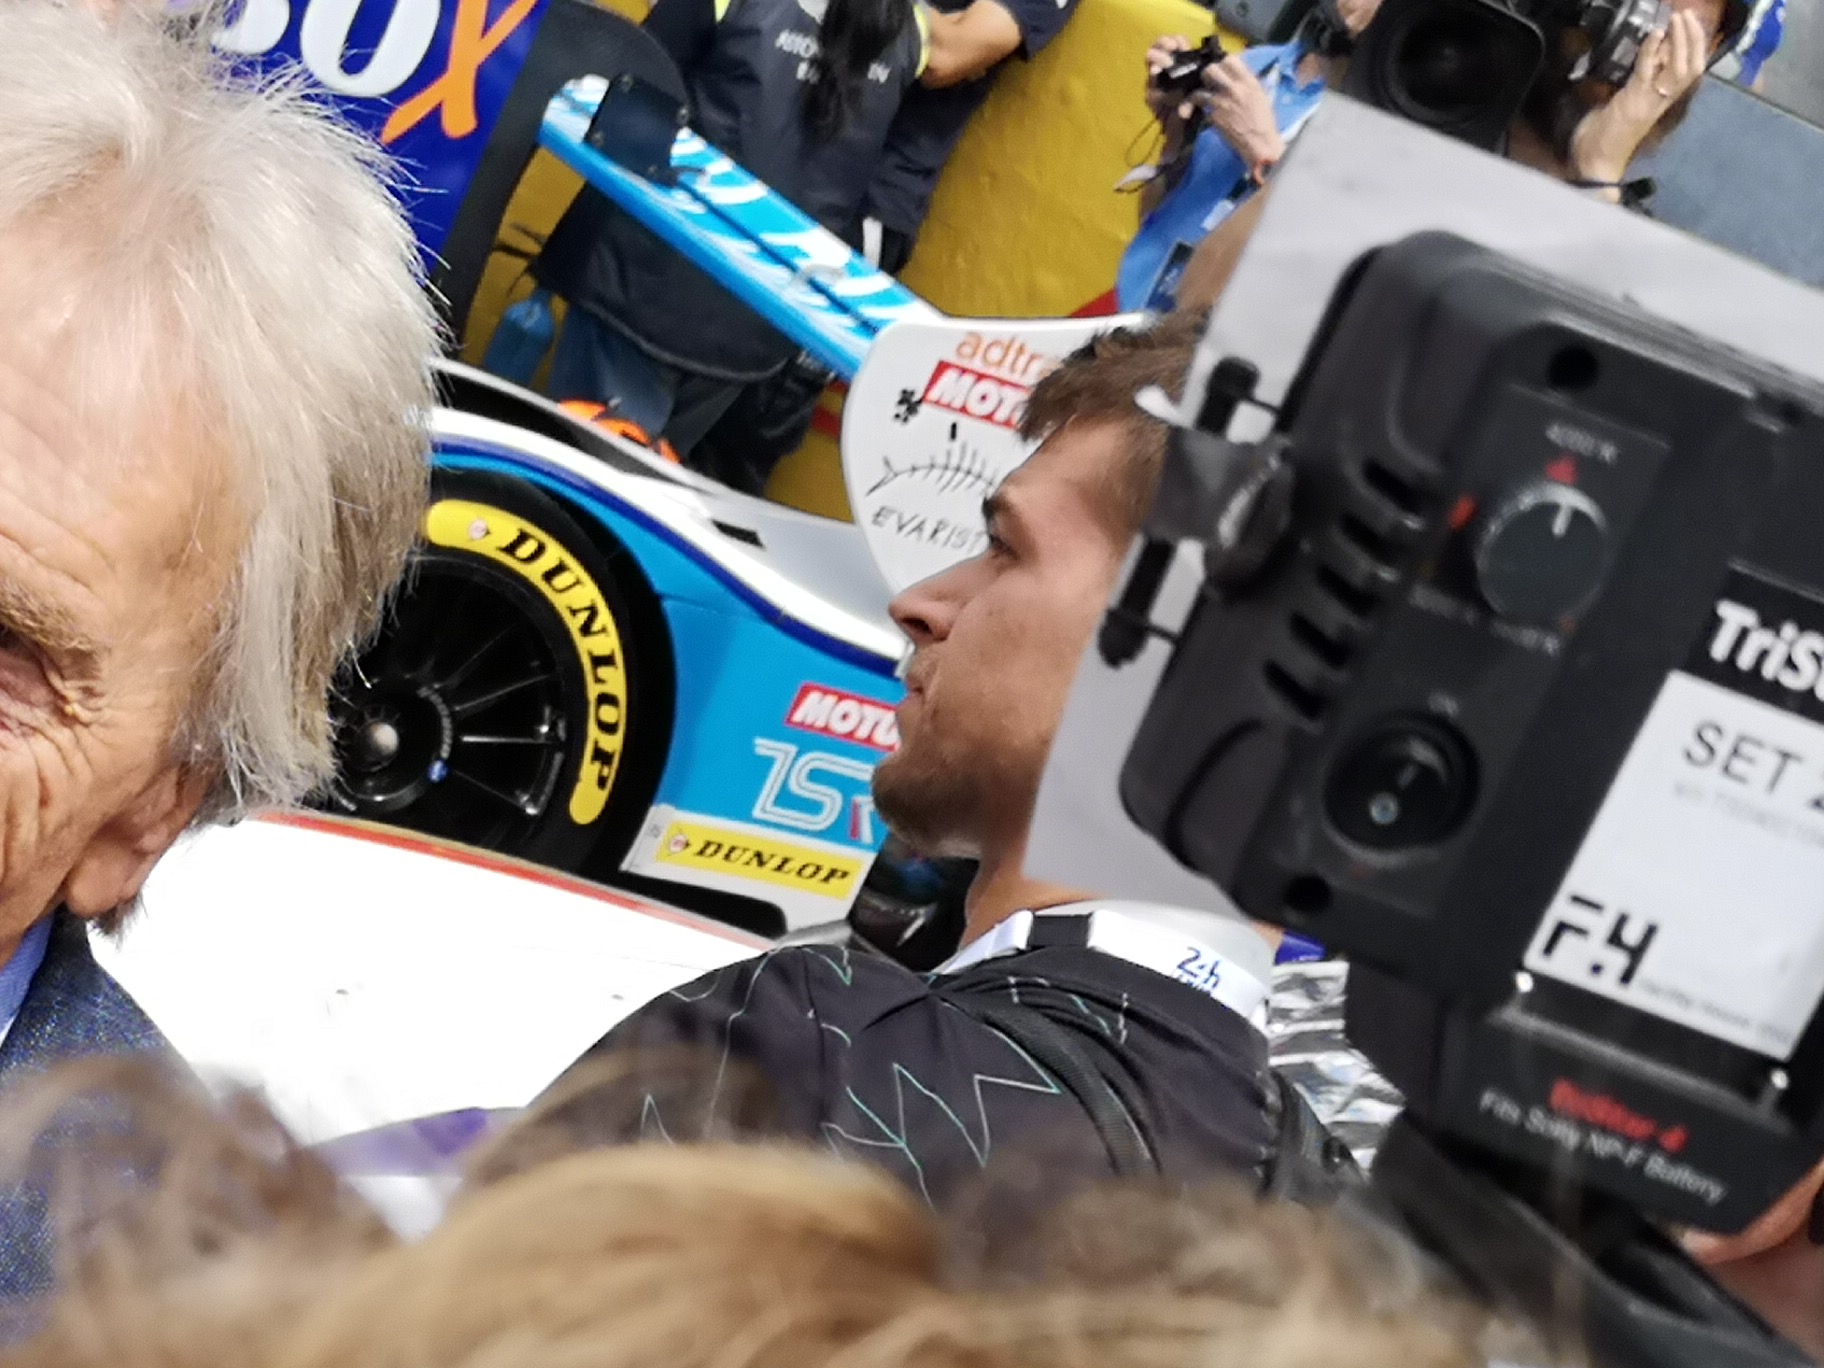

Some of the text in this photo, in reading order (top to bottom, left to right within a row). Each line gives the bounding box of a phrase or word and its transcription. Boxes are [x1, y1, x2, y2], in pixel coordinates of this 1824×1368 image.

[496, 528, 619, 791] DUNLOP
[1708, 598, 1824, 701] TriS
[790, 690, 901, 747] MOTU
[1682, 719, 1803, 796] SET
[694, 838, 851, 885] DUNLOP
